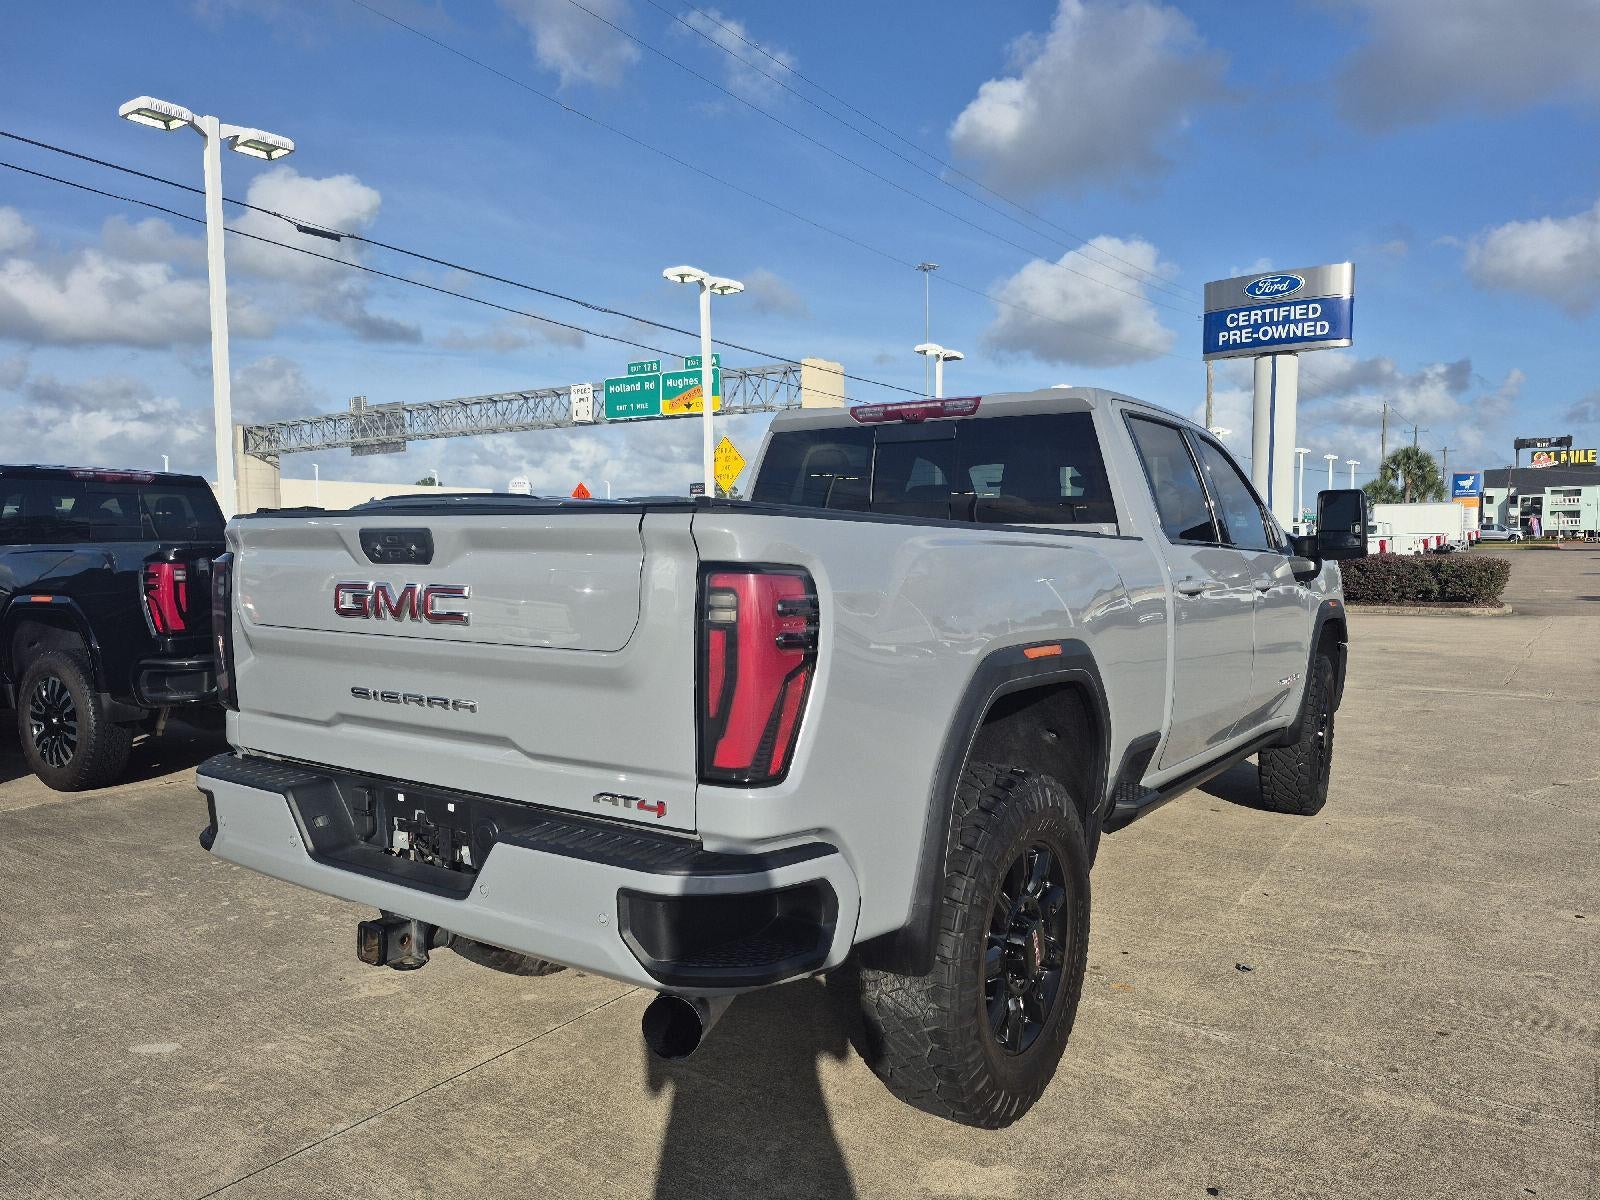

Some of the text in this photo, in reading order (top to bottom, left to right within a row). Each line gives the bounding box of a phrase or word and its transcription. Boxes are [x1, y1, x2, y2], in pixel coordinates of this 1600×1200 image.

[1255, 277, 1291, 295] Ford
[1226, 303, 1322, 328] CERTIFIED
[1218, 320, 1330, 346] PRE-OWNED
[630, 365, 641, 373] EXIT
[687, 359, 699, 367] EXIT
[609, 380, 655, 394] Holland Rd
[666, 376, 699, 389] Hughes
[630, 403, 634, 411] 1
[636, 402, 649, 410] MILE
[1560, 449, 1597, 465] MILE
[334, 580, 471, 627] GMC
[350, 686, 479, 713] SIERRA
[592, 791, 667, 819] AT4
